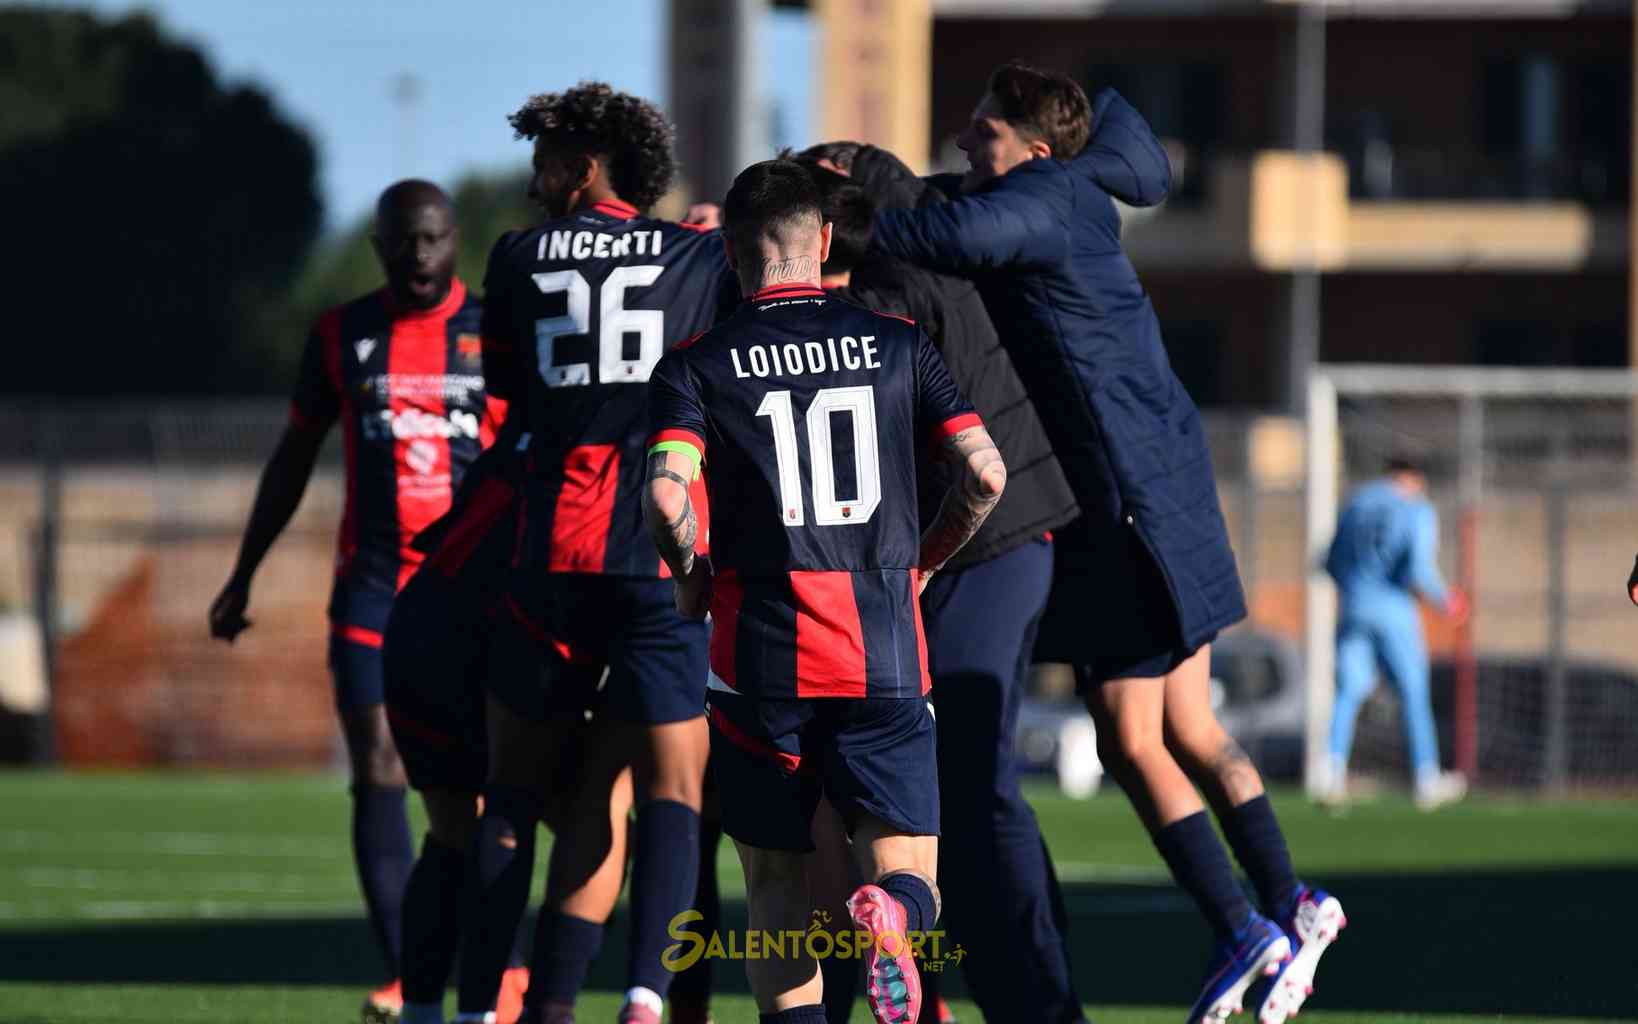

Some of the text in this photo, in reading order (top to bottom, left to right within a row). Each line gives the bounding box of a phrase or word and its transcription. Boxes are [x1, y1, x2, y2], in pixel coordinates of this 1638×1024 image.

[537, 230, 663, 261] INCERTI
[531, 265, 665, 388] 26
[730, 335, 881, 379] LOIODICE
[755, 385, 882, 527] 10
